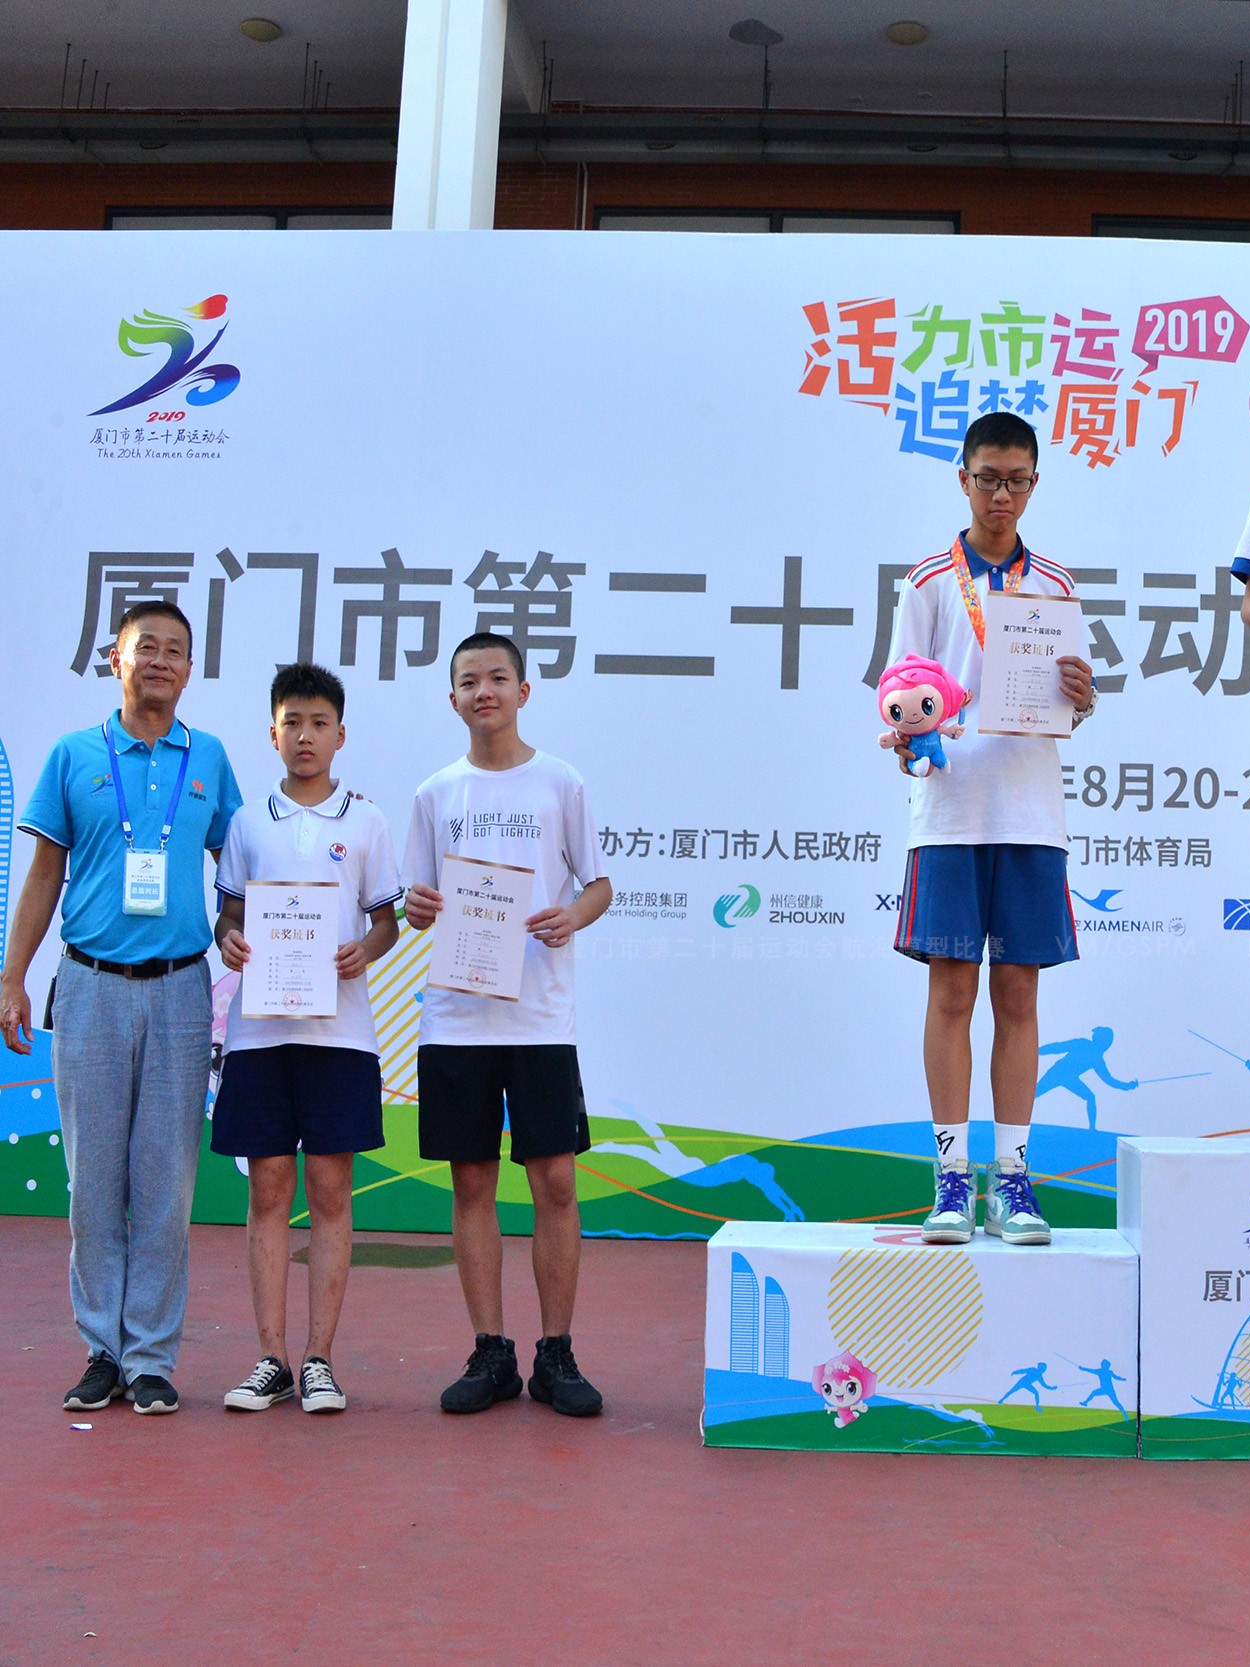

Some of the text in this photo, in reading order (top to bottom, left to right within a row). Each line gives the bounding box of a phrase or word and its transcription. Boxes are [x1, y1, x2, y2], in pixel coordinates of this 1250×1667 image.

[798, 297, 1235, 402] 活力市运 2019
[146, 411, 186, 423] 2019
[90, 427, 230, 445] 厦门市第二十届运动会
[97, 448, 114, 459] The
[117, 448, 141, 459] 20th
[186, 448, 222, 459] Games
[473, 813, 534, 824] LIGHT JUST
[473, 827, 492, 837] GOT
[770, 893, 824, 909] 州信健康
[625, 909, 657, 920] Holding
[661, 910, 687, 920] Group
[769, 911, 845, 924] ZHOUXIN
[1083, 920, 1164, 932] XIAMENAIR
